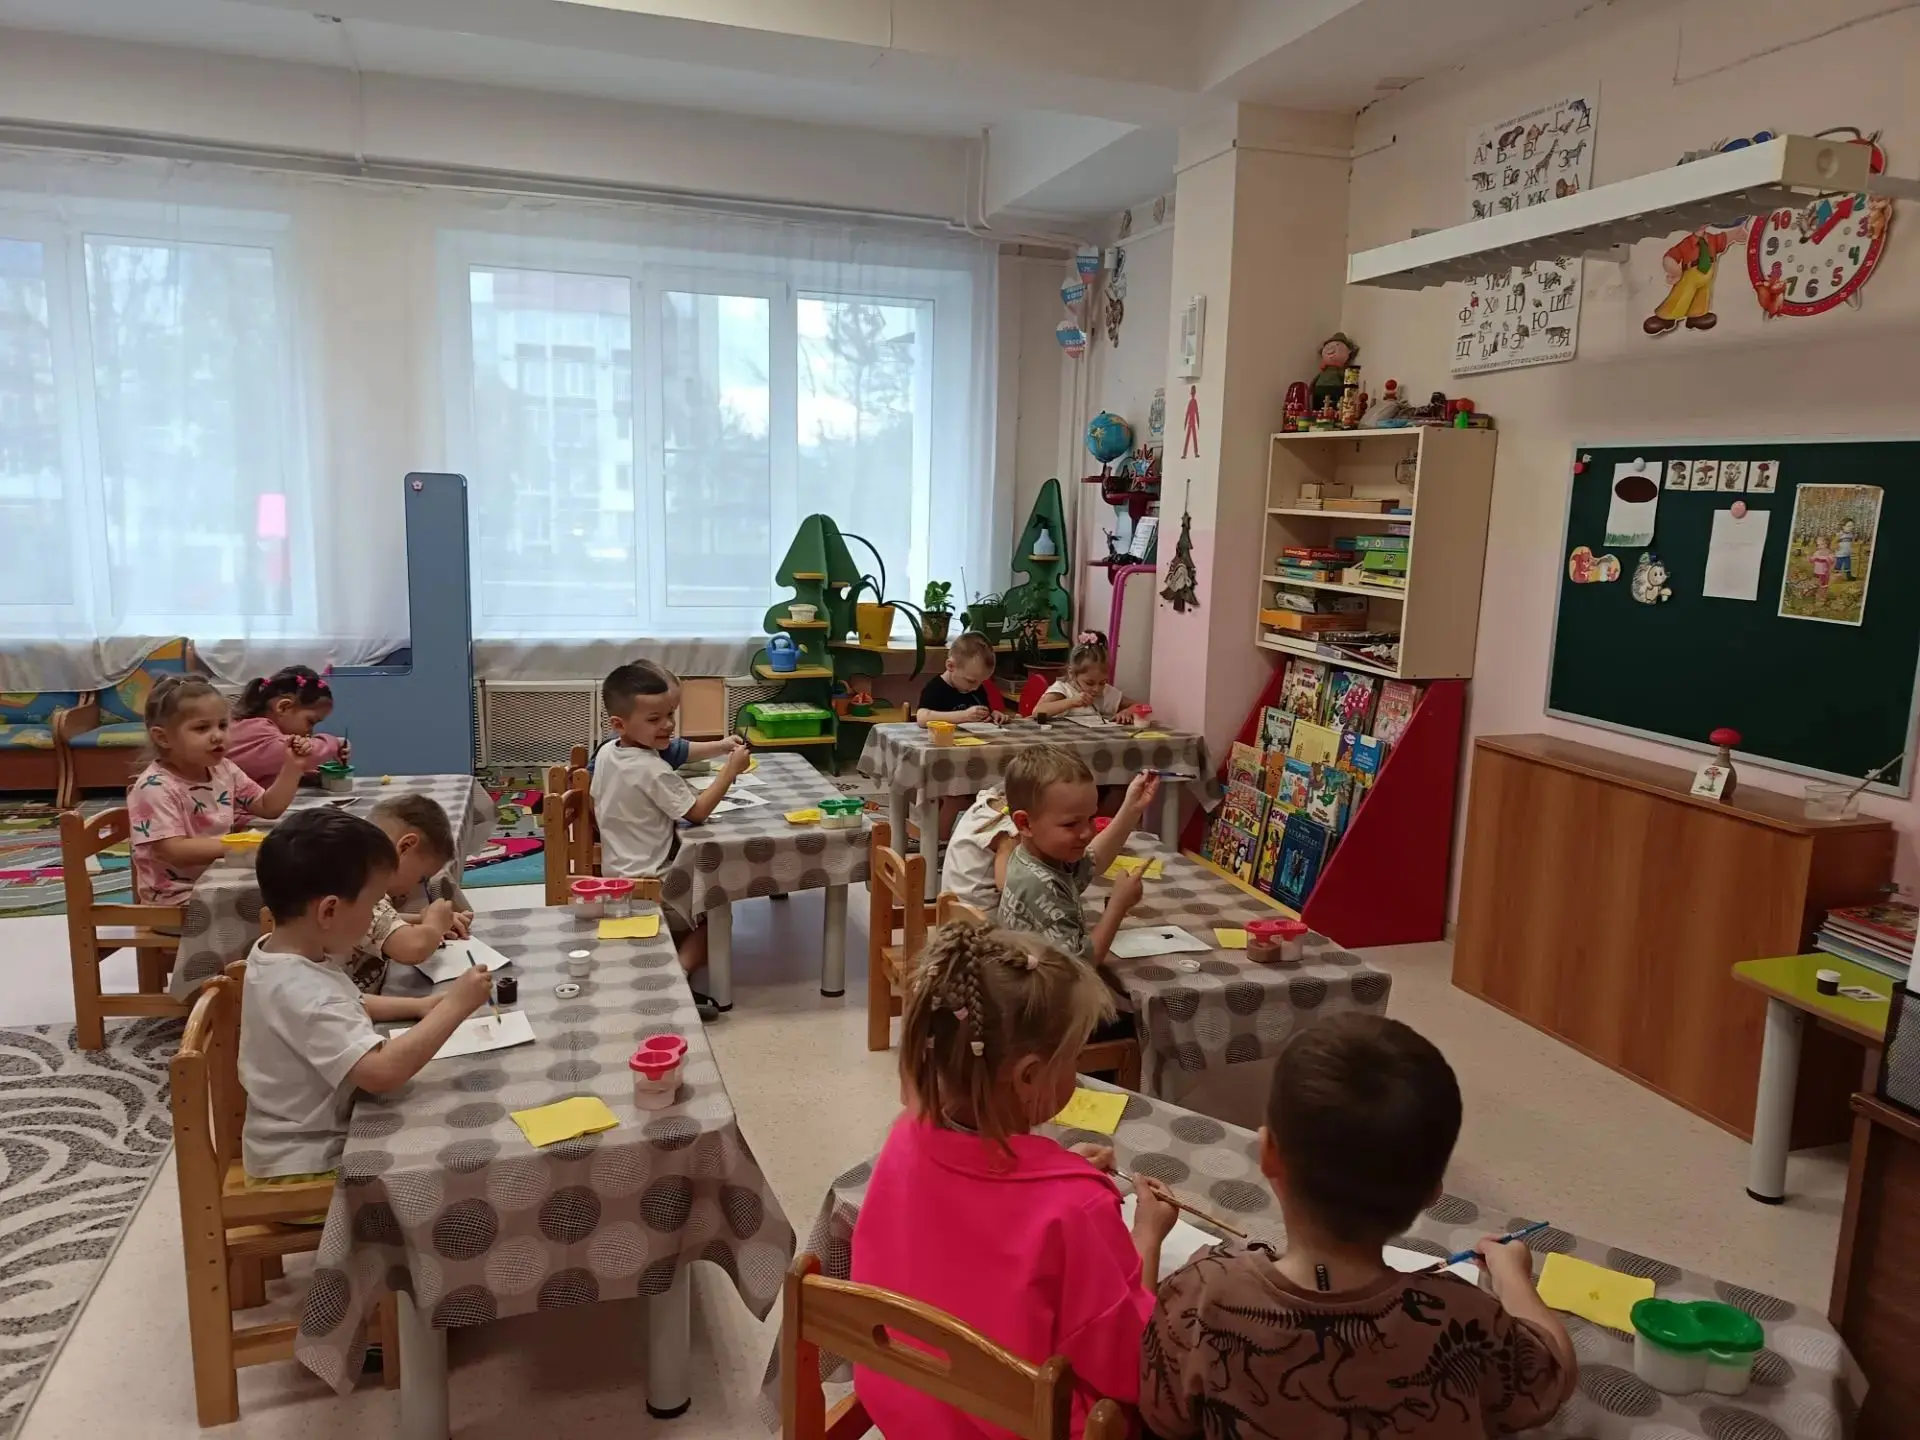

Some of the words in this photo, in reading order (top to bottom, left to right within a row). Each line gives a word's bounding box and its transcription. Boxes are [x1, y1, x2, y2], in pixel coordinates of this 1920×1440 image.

[1523, 141, 1534, 160] В
[1558, 149, 1570, 168] З
[1486, 172, 1496, 190] Е
[1524, 169, 1538, 188] Ж
[1854, 192, 1866, 211] 2
[1771, 210, 1791, 231] 10
[1857, 217, 1868, 237] 3
[1766, 237, 1779, 256] 9
[1848, 245, 1860, 266] 4
[1831, 266, 1844, 287] 5
[1786, 276, 1798, 297] 7
[1805, 278, 1819, 298] 6
[1483, 298, 1494, 314] Х
[1505, 294, 1518, 313] Ц
[1458, 307, 1472, 323] Ф
[1531, 310, 1549, 330] Ю
[1559, 328, 1571, 347] Я
